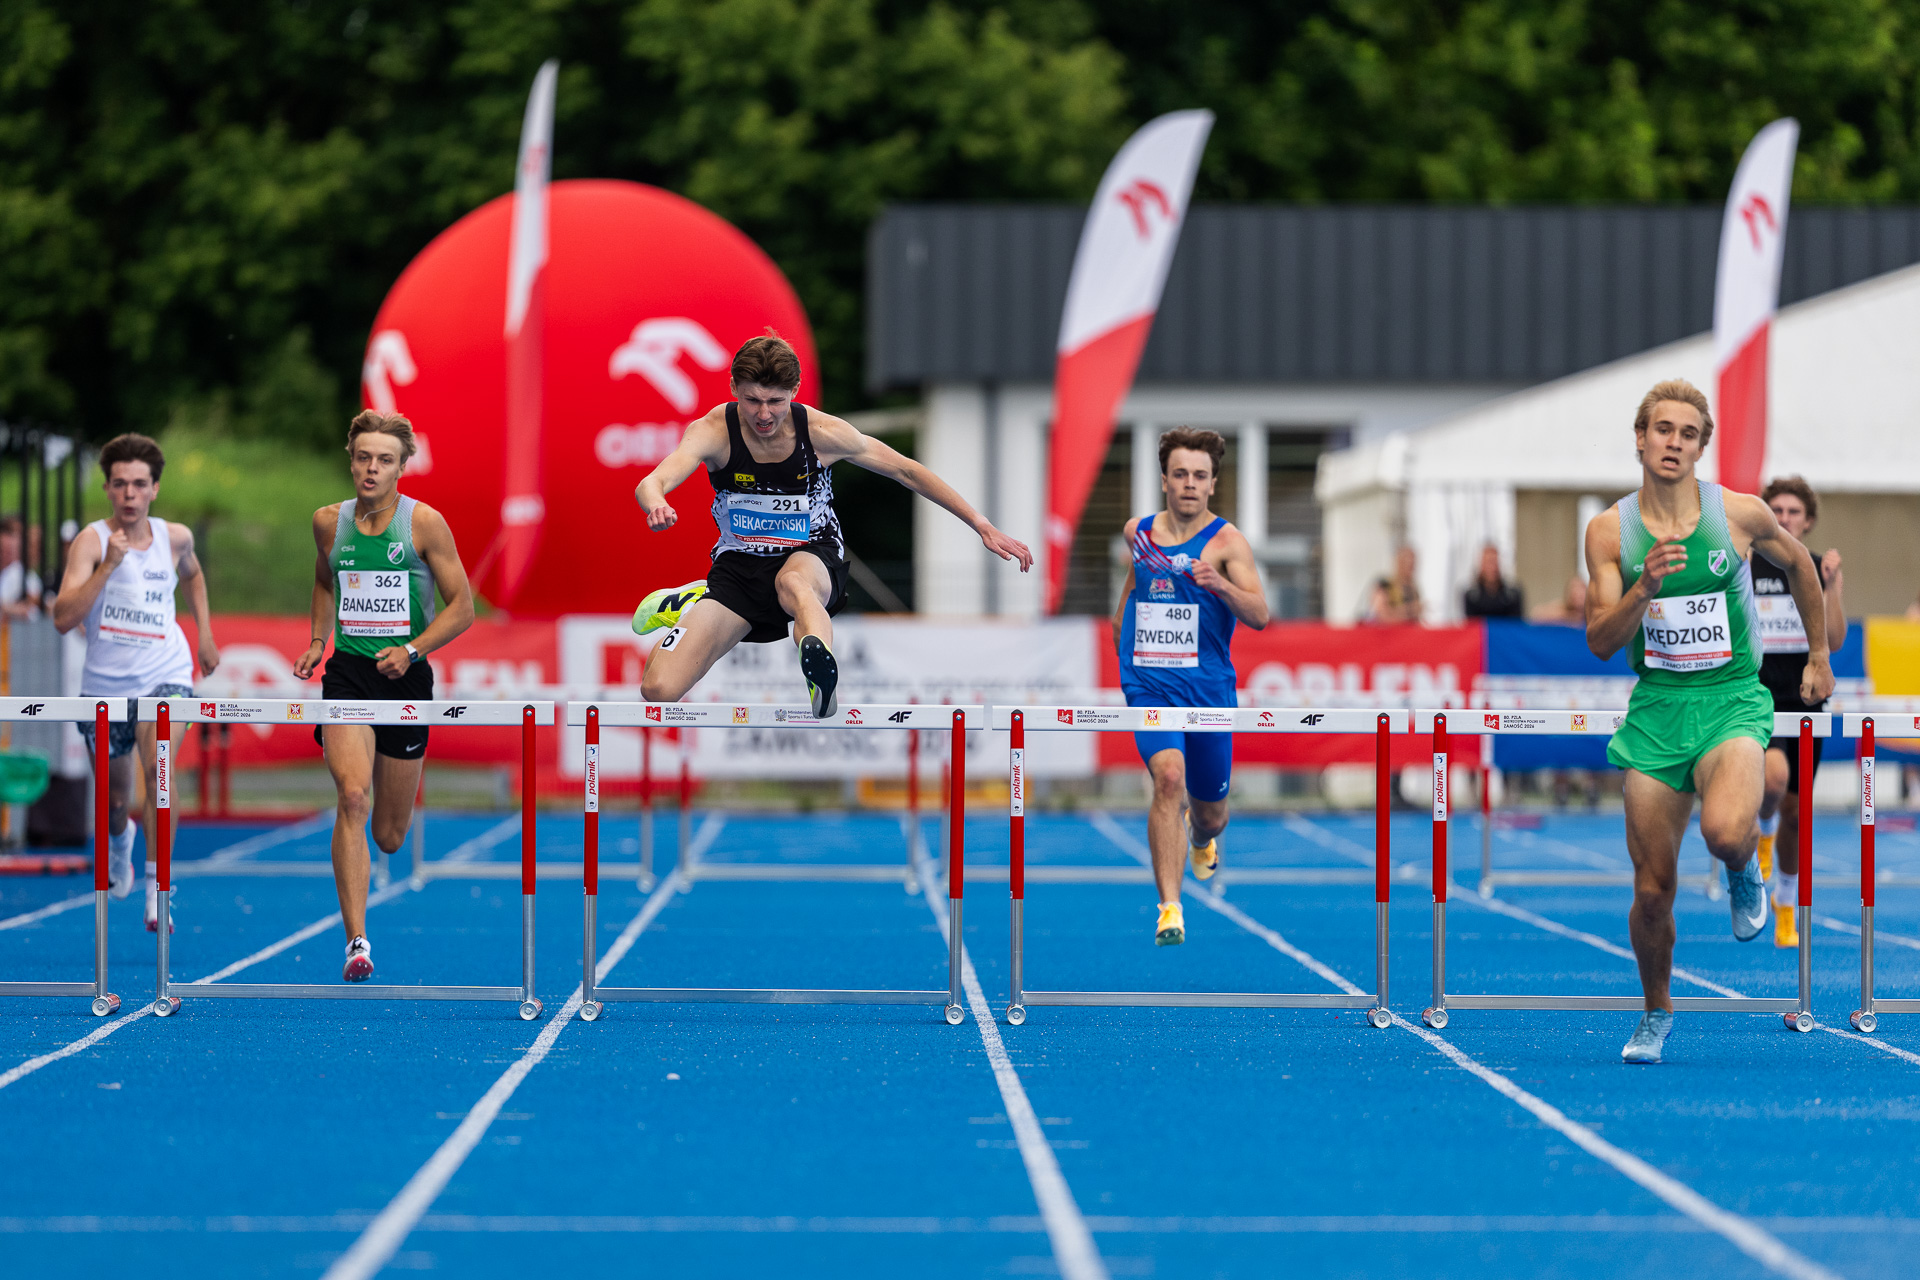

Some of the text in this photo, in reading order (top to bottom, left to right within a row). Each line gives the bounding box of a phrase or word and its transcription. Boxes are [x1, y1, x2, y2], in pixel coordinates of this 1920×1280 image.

[772, 498, 802, 512] 291
[732, 513, 806, 533] SIEKACZYŃSKI
[375, 575, 402, 588] 362
[145, 591, 163, 603] 194
[342, 597, 406, 613] BANASZEK
[1165, 607, 1192, 620] 480
[1686, 597, 1717, 615] 367
[104, 604, 164, 627] DUTKIEWICZ
[350, 627, 377, 635] ZAMOŚĆ
[661, 628, 680, 648] 6
[1136, 629, 1195, 645] SZWEDKA
[1645, 625, 1725, 648] KĘDZIOR
[1661, 660, 1714, 669] ZAMOŚĆ 2026
[20, 703, 45, 716] 4F
[443, 706, 468, 718] 4F
[888, 711, 913, 723] 4F
[1300, 713, 1325, 726] 4F
[158, 757, 167, 792] polanik
[588, 760, 596, 796] polanik
[1012, 765, 1021, 800] polanik
[1436, 769, 1445, 804] polanik
[1863, 772, 1872, 808] polanik
